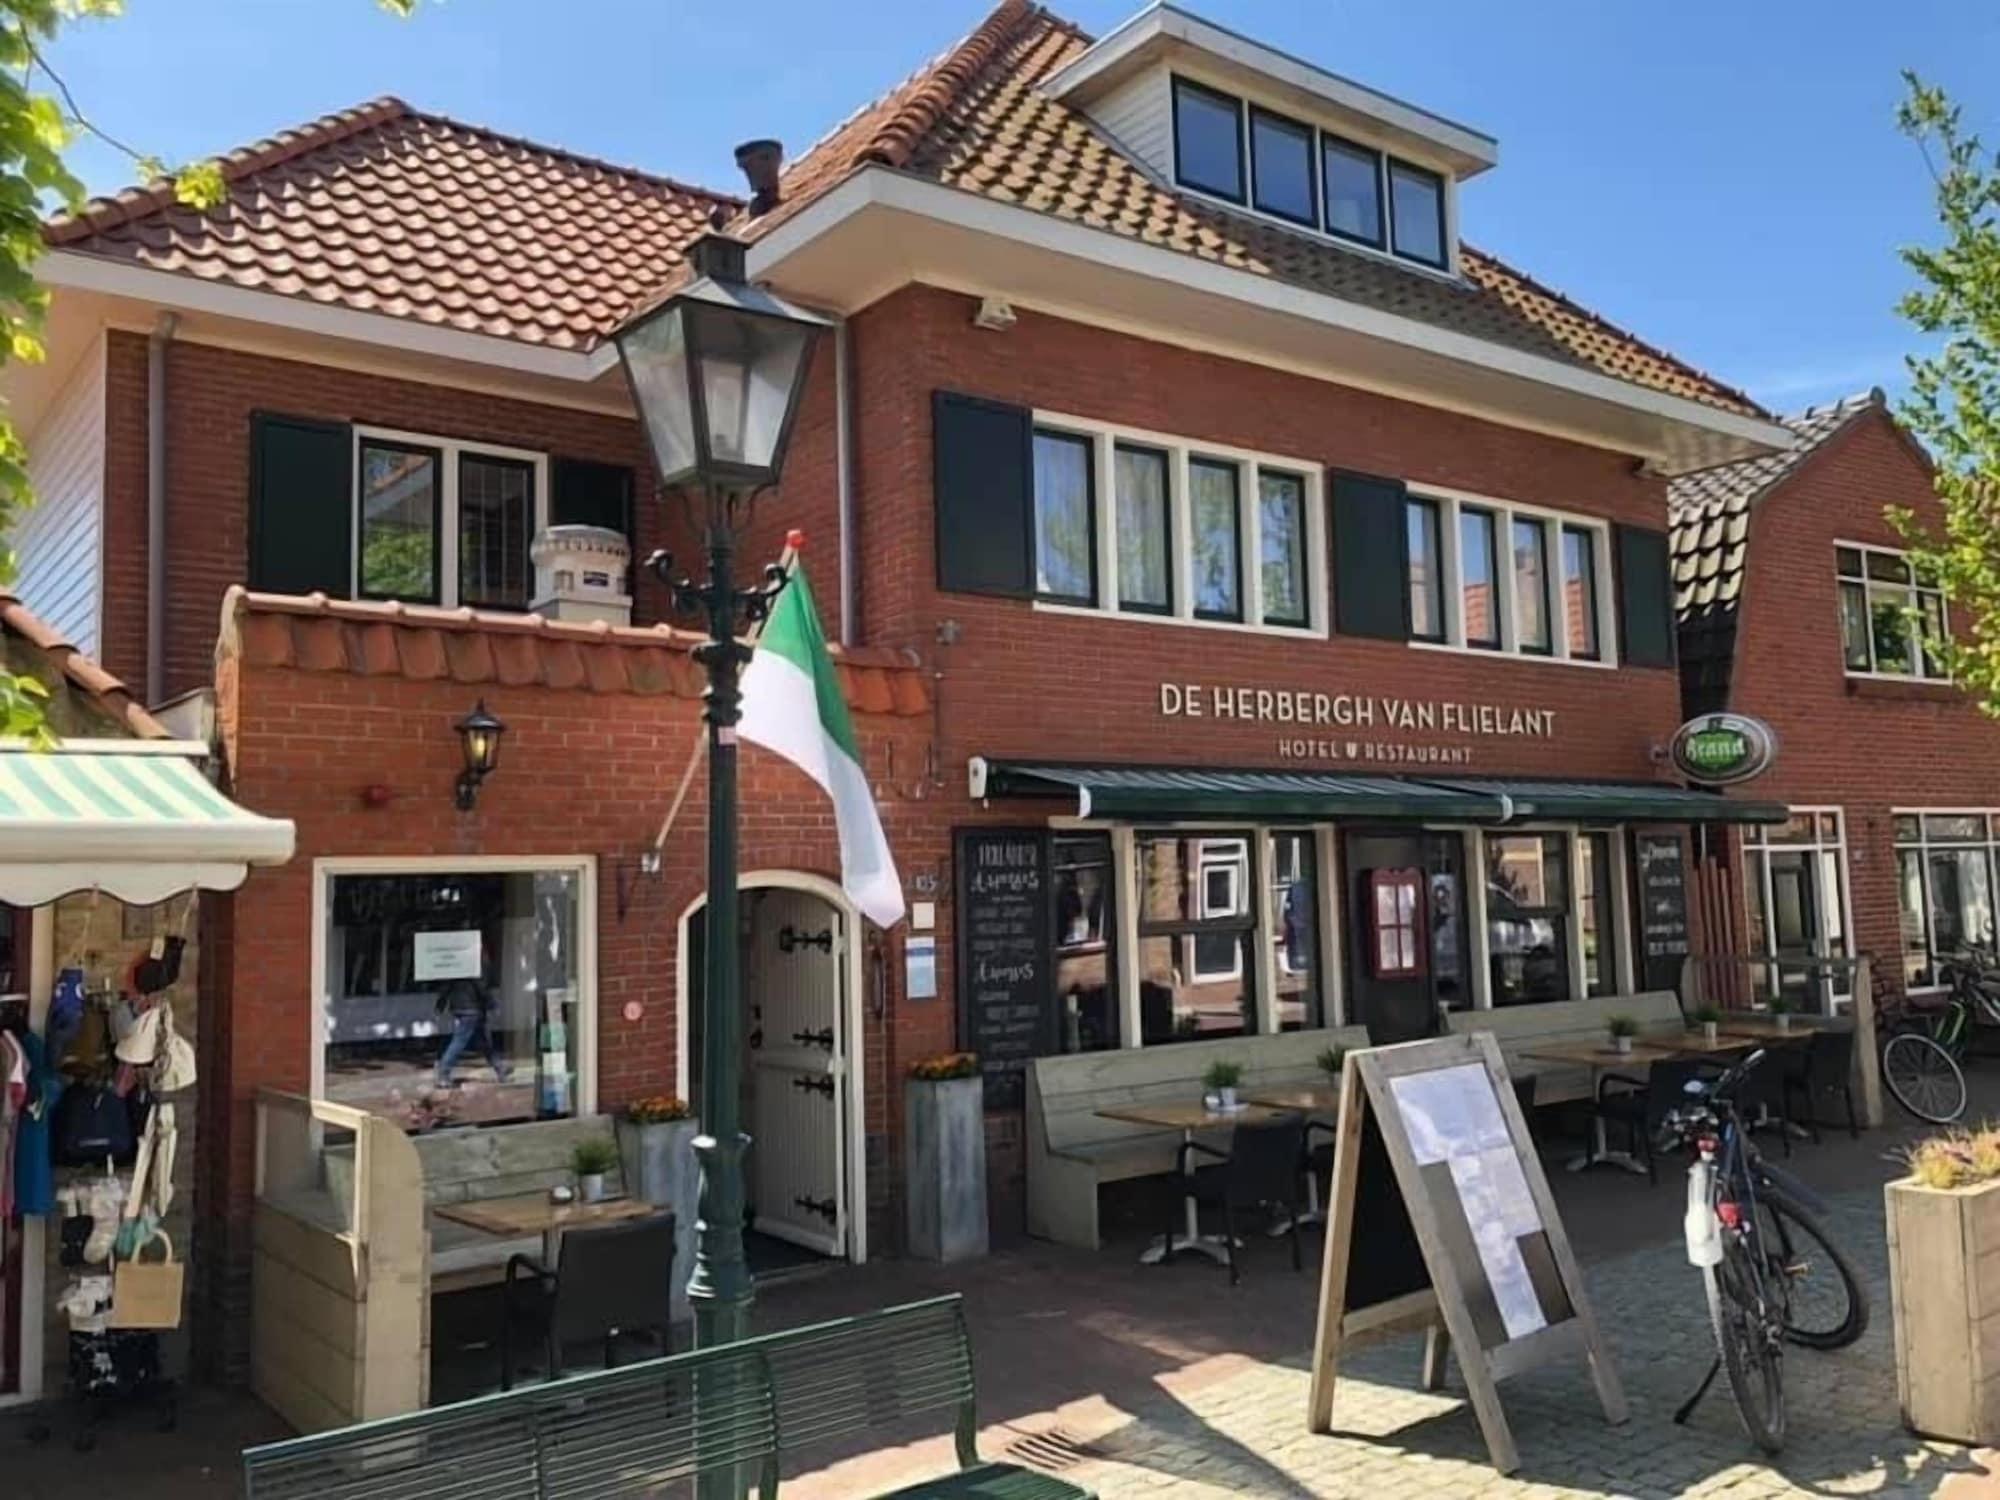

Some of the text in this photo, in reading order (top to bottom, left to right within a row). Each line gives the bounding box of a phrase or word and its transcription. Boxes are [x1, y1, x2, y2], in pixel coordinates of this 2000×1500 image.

[1161, 683, 1556, 738] DE HERBERGH VAN FLIELANT
[1279, 739, 1472, 763] HOTEL RESTAURANT
